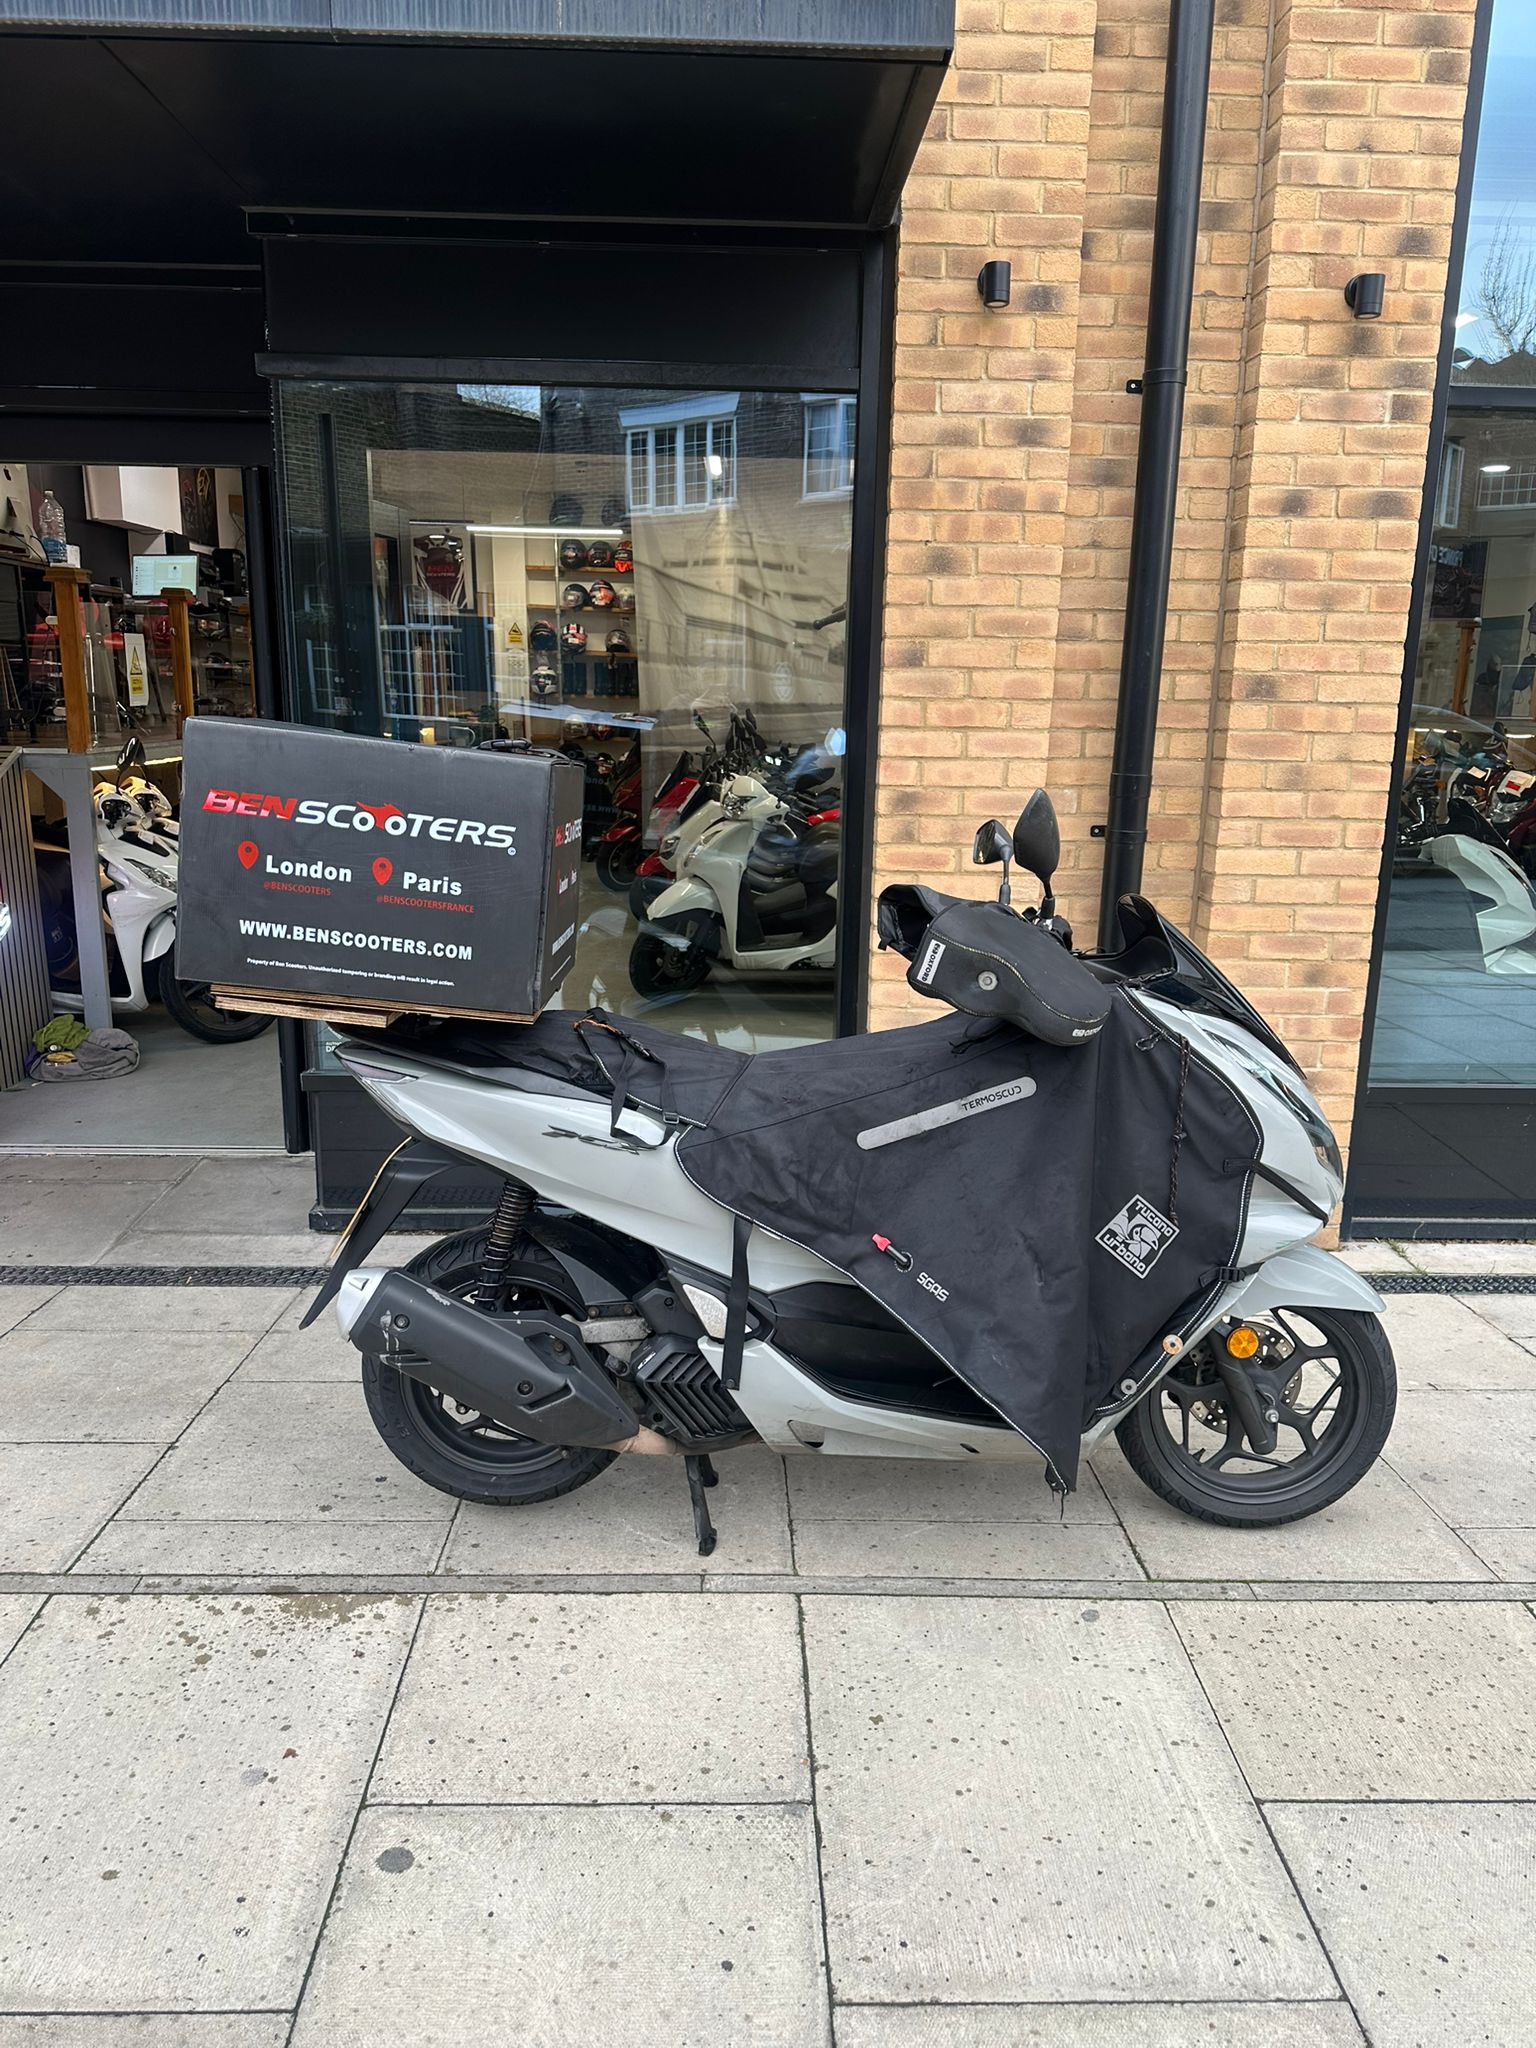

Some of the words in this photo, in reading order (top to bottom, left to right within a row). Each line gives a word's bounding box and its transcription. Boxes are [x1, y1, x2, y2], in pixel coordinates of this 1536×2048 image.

[266, 854, 353, 883] London
[263, 881, 332, 896] @BENSCOOTERS
[402, 871, 463, 896] Paris
[376, 895, 475, 914] @BENSCOOTERSFRANCE
[239, 919, 473, 960] WWW.BENSCOOTERS.COM
[921, 954, 937, 982] OXFORD
[962, 1085, 1022, 1111] TERMOSCUD
[917, 1272, 950, 1302] SGAS
